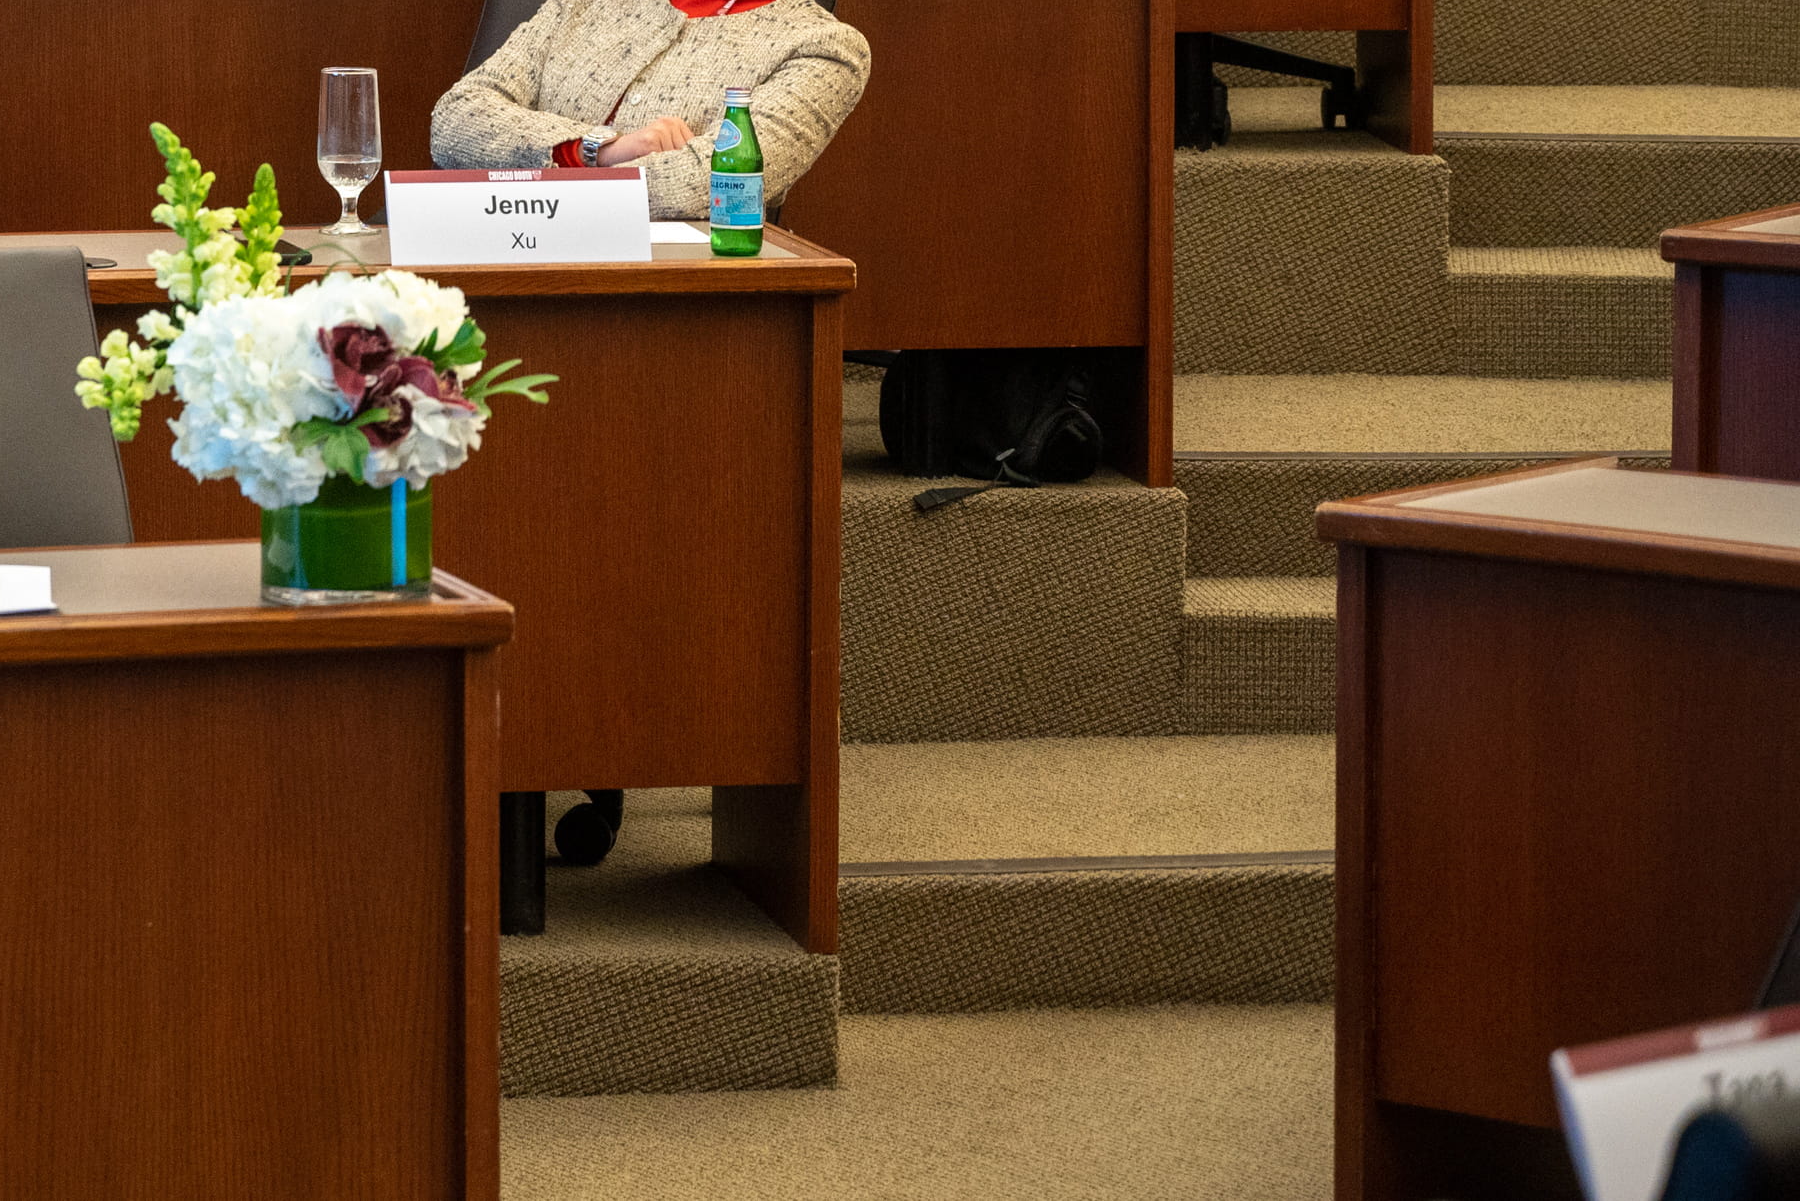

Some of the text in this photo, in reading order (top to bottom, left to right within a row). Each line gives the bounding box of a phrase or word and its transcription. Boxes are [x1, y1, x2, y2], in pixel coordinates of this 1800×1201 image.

[488, 171, 513, 181] CHICAGO
[484, 195, 559, 219] Jenny
[511, 232, 537, 249] Xu
